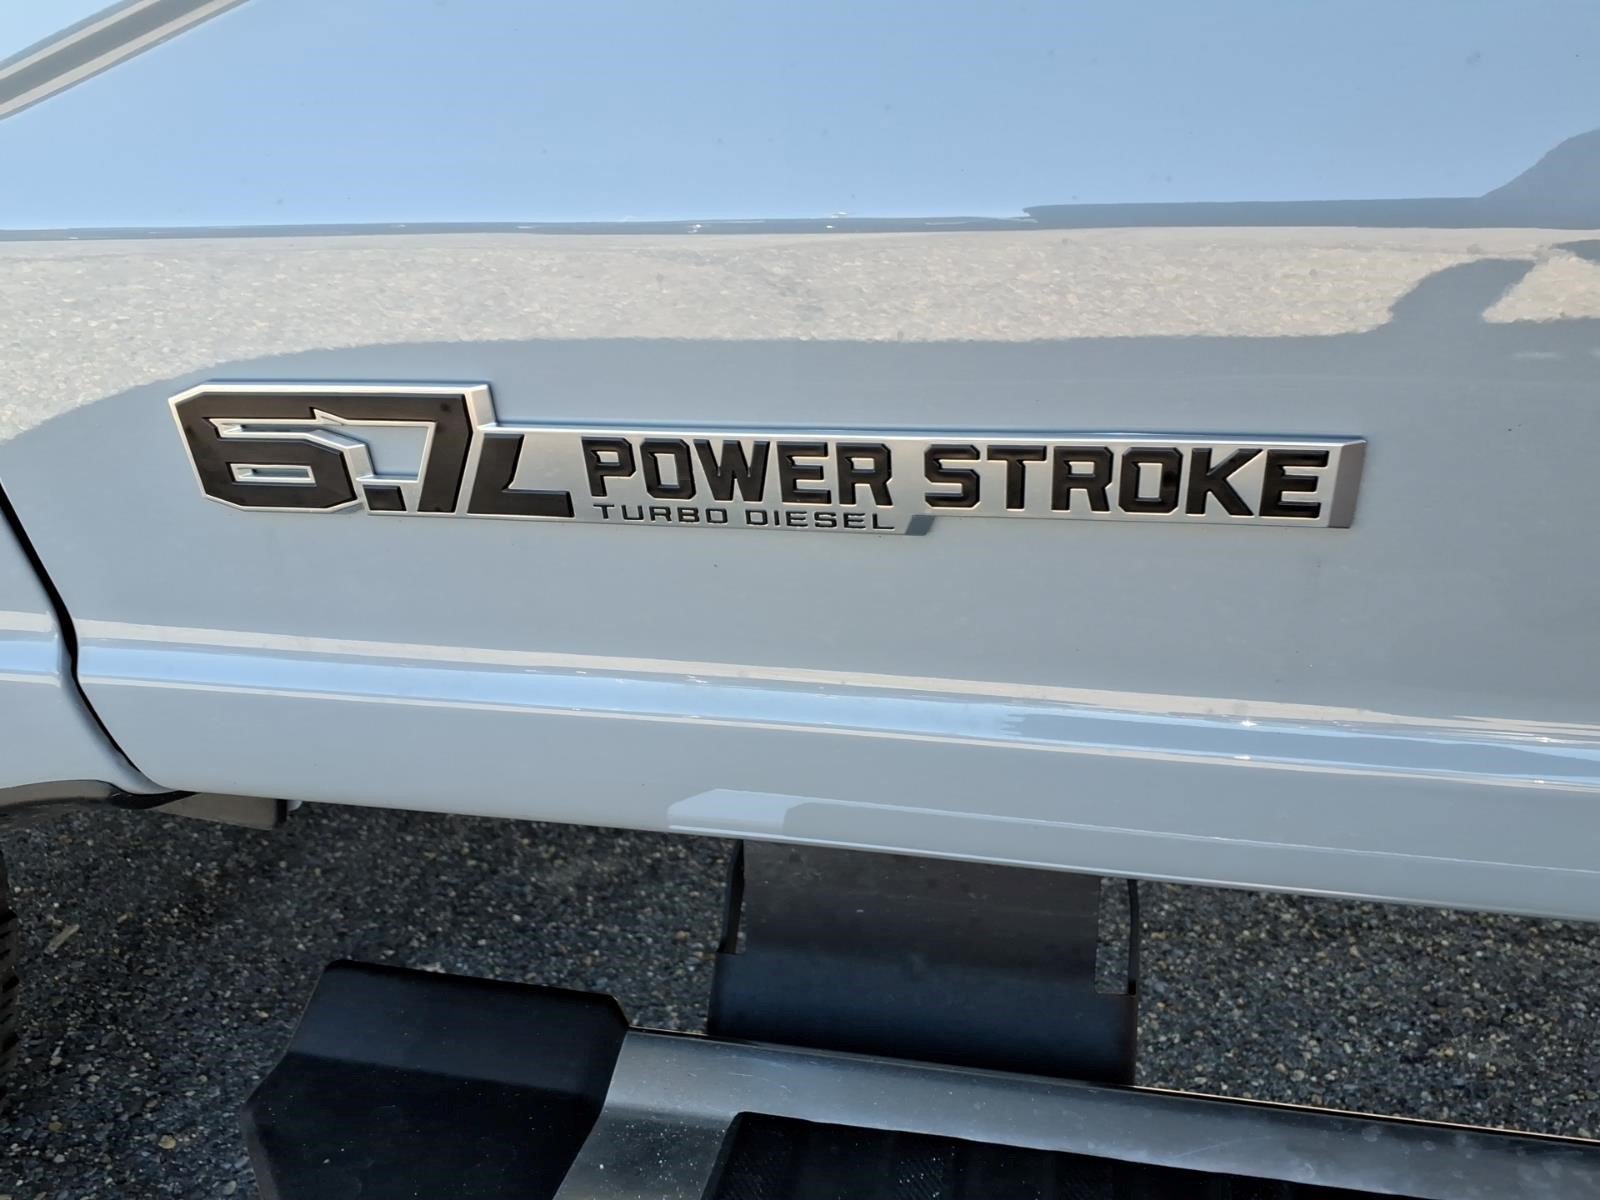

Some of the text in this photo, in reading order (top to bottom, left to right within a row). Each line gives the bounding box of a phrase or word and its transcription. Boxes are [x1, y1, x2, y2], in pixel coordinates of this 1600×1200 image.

[174, 391, 1329, 519] 6.7L POWER STROKE
[593, 503, 895, 531] TURBO DIESEL
